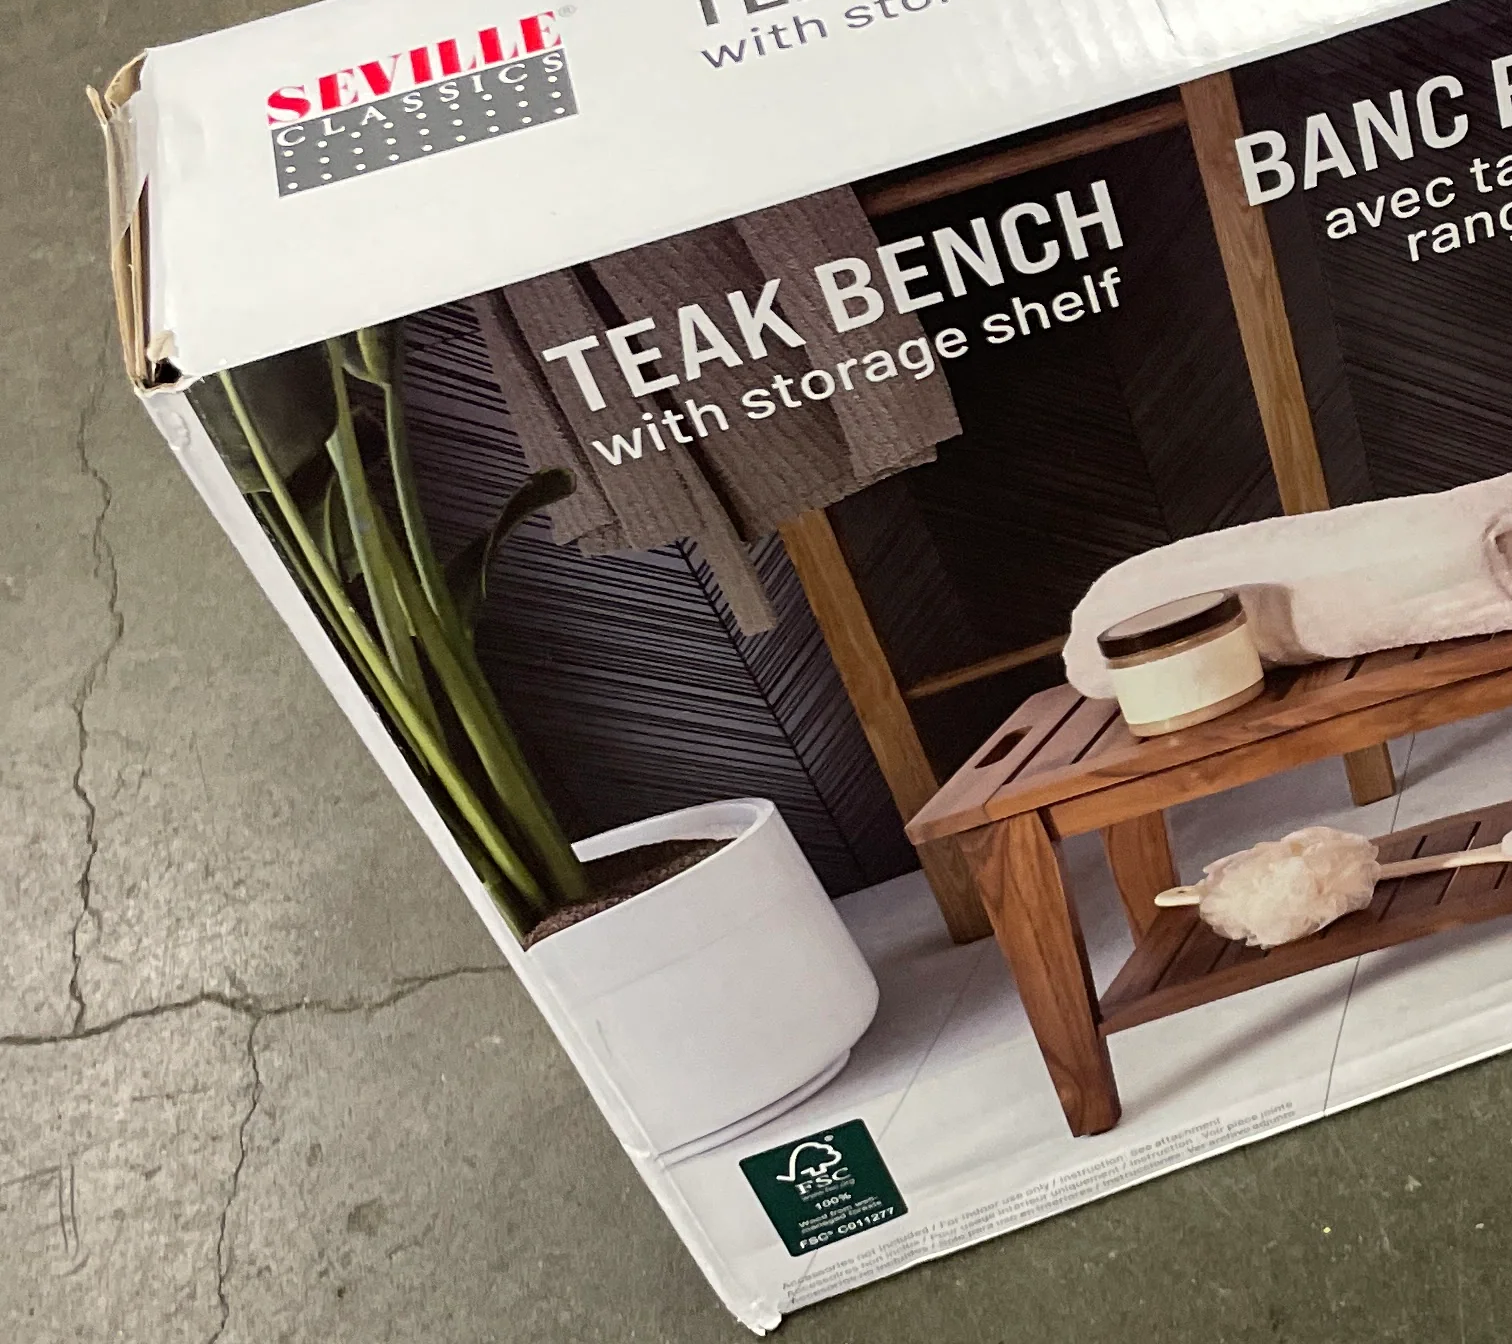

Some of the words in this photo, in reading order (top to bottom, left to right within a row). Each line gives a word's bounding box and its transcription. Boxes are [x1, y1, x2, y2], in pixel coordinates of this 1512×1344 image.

[266, 11, 562, 126] SEVILLE
[700, 14, 828, 68] with
[276, 52, 564, 147] CLASSICS
[1235, 75, 1469, 207] BANC
[1325, 176, 1455, 241] avec
[543, 278, 806, 412] TEAK
[815, 179, 1124, 333] BENCH
[592, 399, 730, 466] with
[740, 327, 969, 420] storage
[981, 266, 1122, 345] shelf
[795, 1167, 852, 1195] FSC
[815, 1192, 852, 1210] 100%
